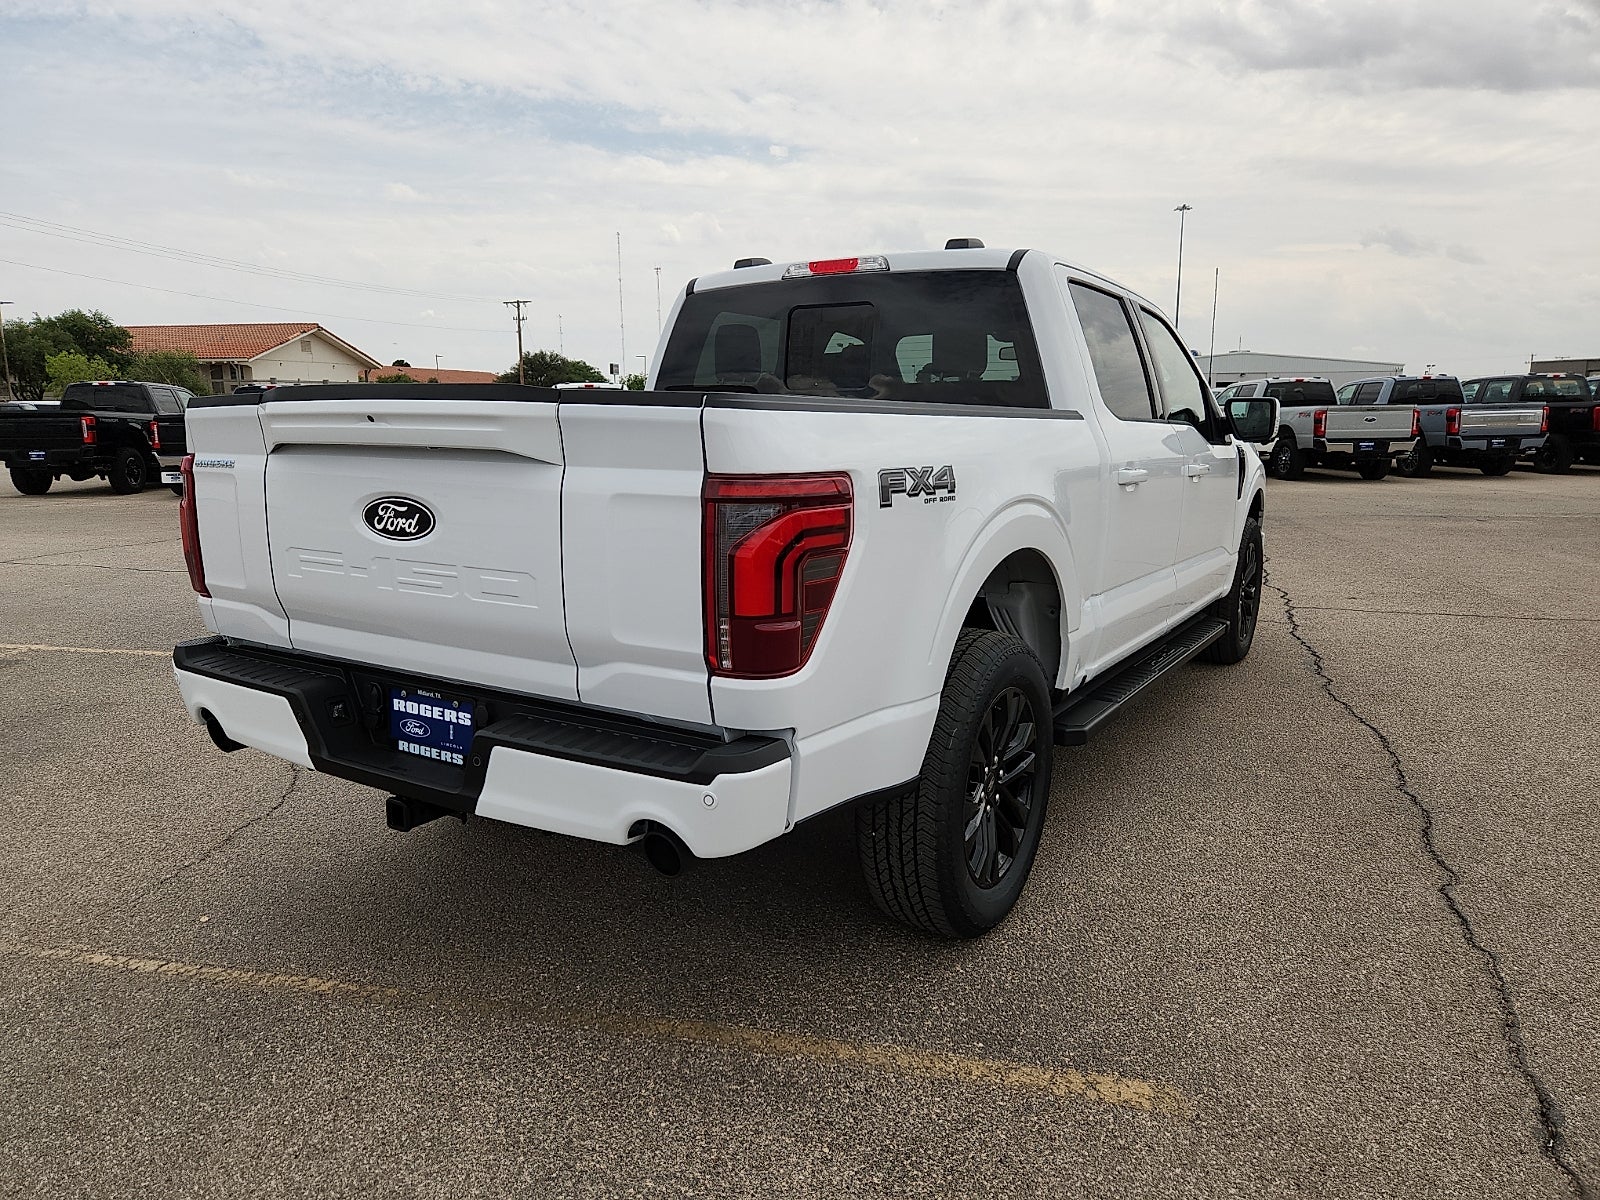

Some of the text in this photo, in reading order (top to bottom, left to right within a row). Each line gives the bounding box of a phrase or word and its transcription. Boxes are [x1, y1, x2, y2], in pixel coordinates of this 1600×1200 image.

[877, 464, 956, 509] FX4
[924, 495, 956, 505] OFF ROAD
[374, 502, 419, 534] Ford
[286, 546, 539, 609] F-150
[393, 698, 472, 726] ROGERS
[405, 720, 425, 736] Ford
[398, 740, 464, 766] ROGERS
[440, 741, 463, 750] LINCOLN
